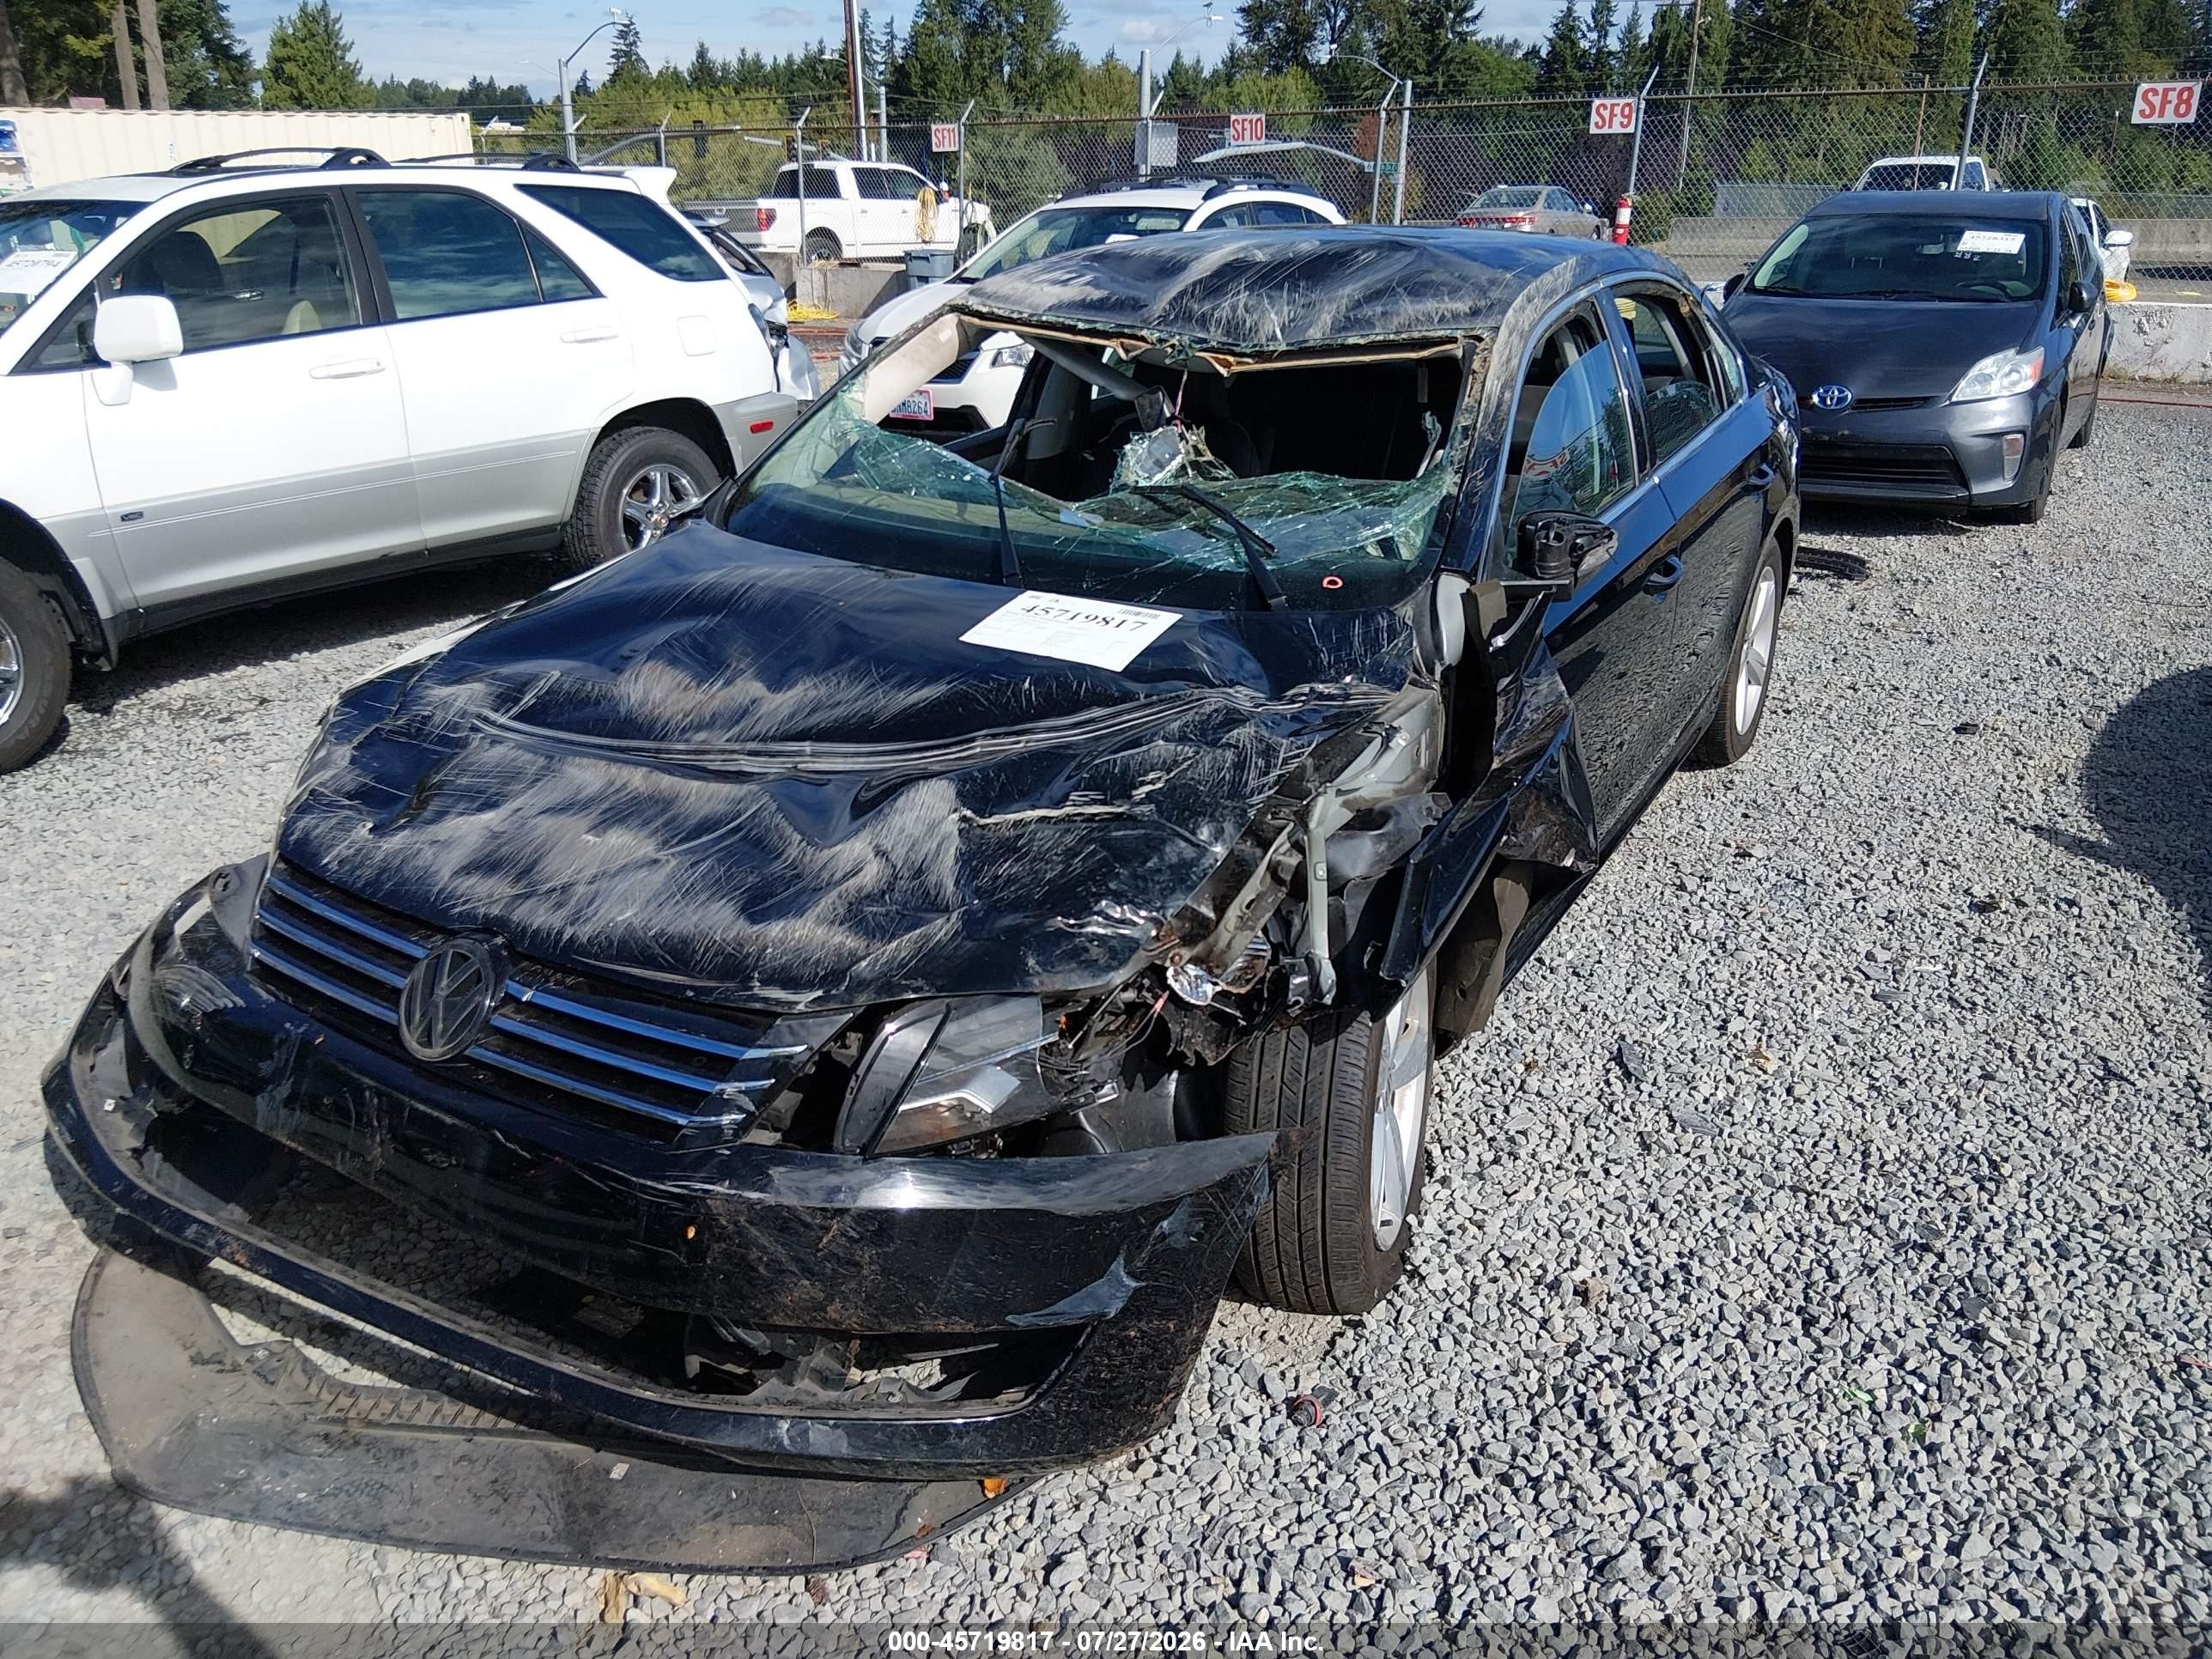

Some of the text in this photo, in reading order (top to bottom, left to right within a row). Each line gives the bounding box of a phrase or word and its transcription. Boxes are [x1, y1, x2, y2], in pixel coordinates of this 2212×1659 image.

[1594, 101, 1634, 130] SF9
[2138, 86, 2195, 119] SF8
[933, 127, 957, 149] SF11
[1231, 117, 1264, 142] SF10
[1021, 605, 1148, 632] 45719817
